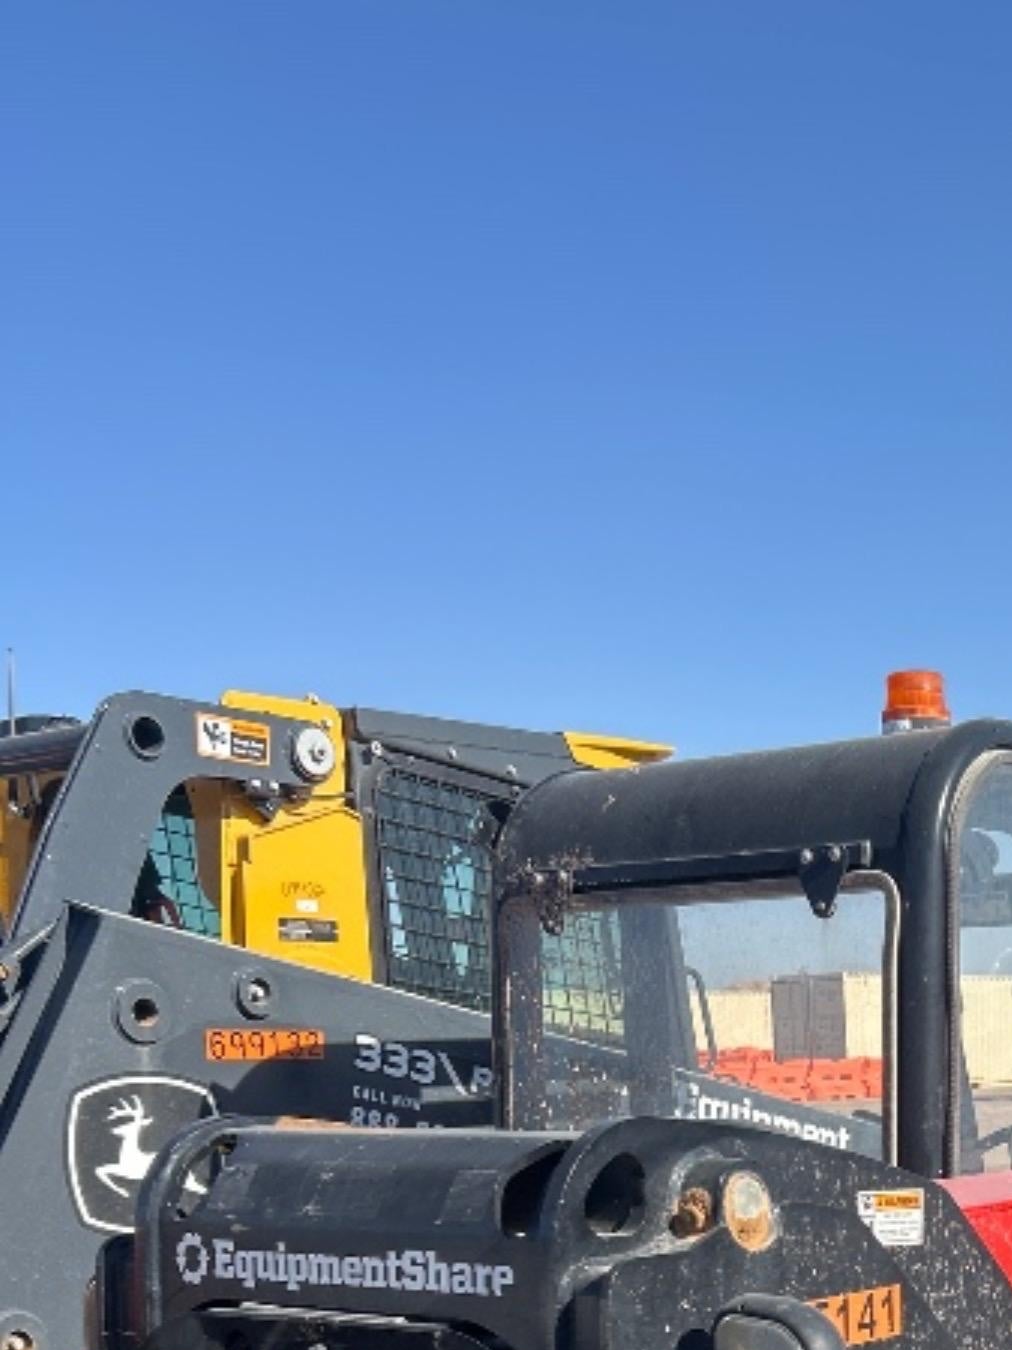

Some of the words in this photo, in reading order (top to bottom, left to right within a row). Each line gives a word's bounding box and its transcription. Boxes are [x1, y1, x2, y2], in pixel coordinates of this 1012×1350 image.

[208, 1030, 322, 1059] 699132
[211, 1238, 515, 1297] EquipmentShare
[815, 1288, 896, 1342] 141
